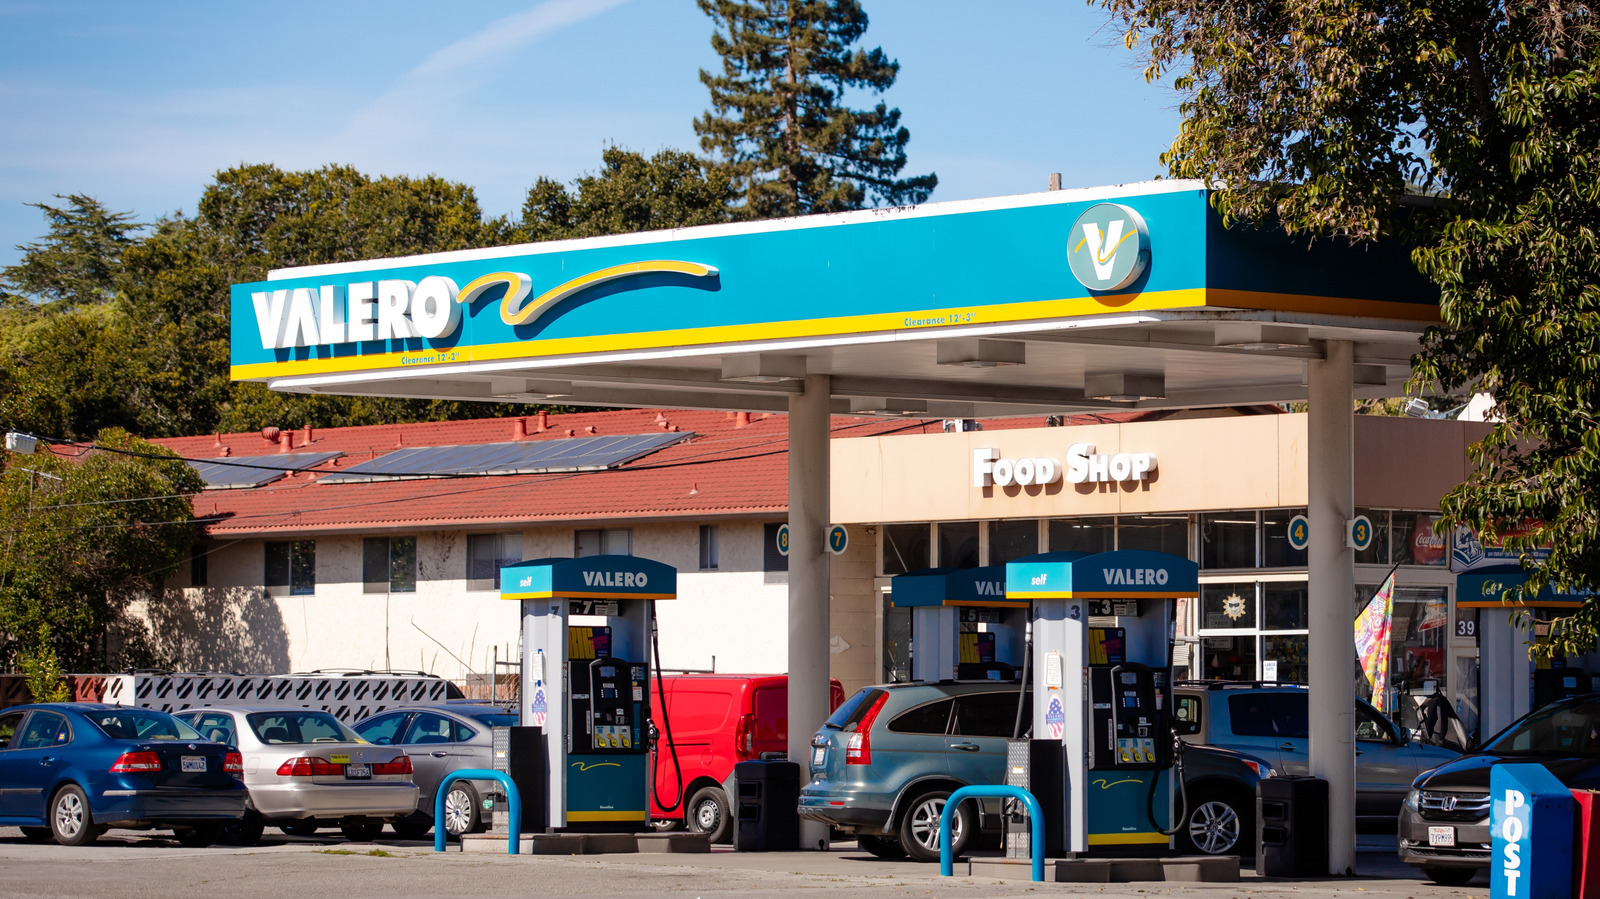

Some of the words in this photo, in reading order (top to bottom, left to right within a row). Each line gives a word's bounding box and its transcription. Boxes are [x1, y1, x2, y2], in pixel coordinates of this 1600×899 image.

[251, 275, 461, 350] VALERO
[904, 317, 946, 327] Clearance
[401, 355, 435, 365] Clearance
[781, 532, 788, 548] 8
[834, 532, 842, 547] 7
[1294, 524, 1304, 541] 4
[1356, 524, 1366, 541] 3
[519, 576, 533, 588] self
[582, 571, 648, 588] VALERO
[1031, 573, 1048, 587] self
[1102, 568, 1169, 585] VALERO
[975, 581, 1006, 596] VAL
[551, 605, 560, 619] 7
[582, 600, 593, 615] 7
[1070, 604, 1081, 620] 3
[1101, 599, 1111, 615] 3
[1458, 620, 1475, 636] 39
[1502, 788, 1525, 897] POST
